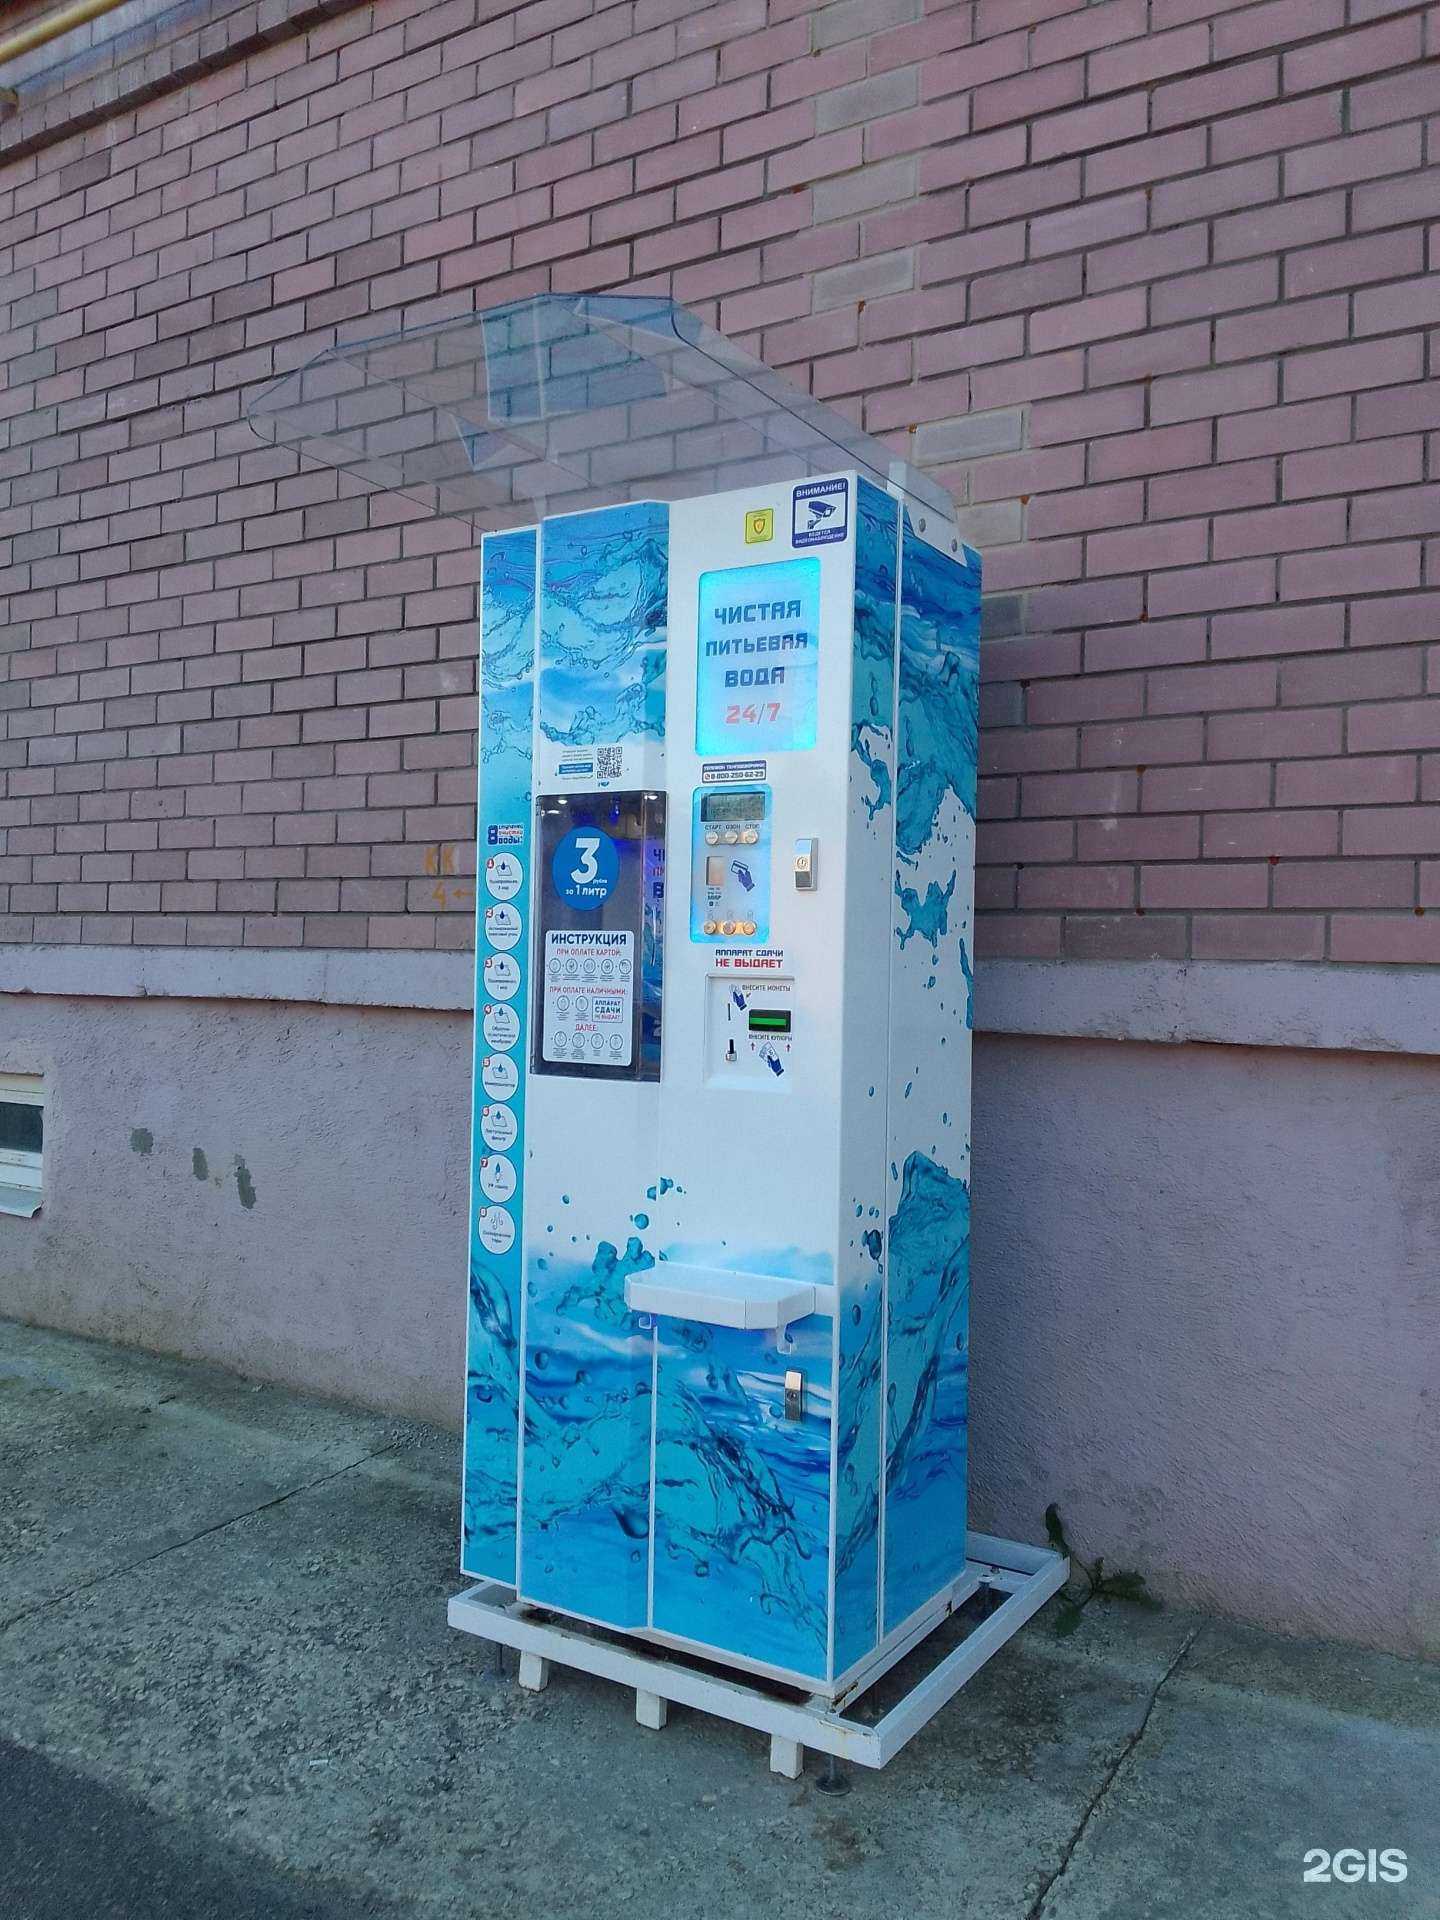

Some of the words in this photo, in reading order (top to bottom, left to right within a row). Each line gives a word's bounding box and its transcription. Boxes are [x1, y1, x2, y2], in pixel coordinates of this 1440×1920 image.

[796, 482, 846, 498] ВНИМАНИЕ!
[714, 600, 801, 625] ЧИСТАЯ
[705, 632, 808, 657] ПИТЬЕВАЯ
[724, 666, 785, 688] ВОДА
[726, 703, 781, 724] 24/7
[487, 825, 498, 845] 8
[570, 837, 601, 884] 3
[575, 885, 580, 896] 1
[581, 887, 607, 898] литр
[551, 933, 627, 946] ИНСТРУКЦИЯ
[715, 949, 752, 957] АППАРАТ
[755, 949, 784, 957] СДАЧИ
[715, 958, 730, 967] НЕ
[734, 959, 784, 969] ВЫДАЕТ
[594, 1006, 621, 1014] СДАЧИ
